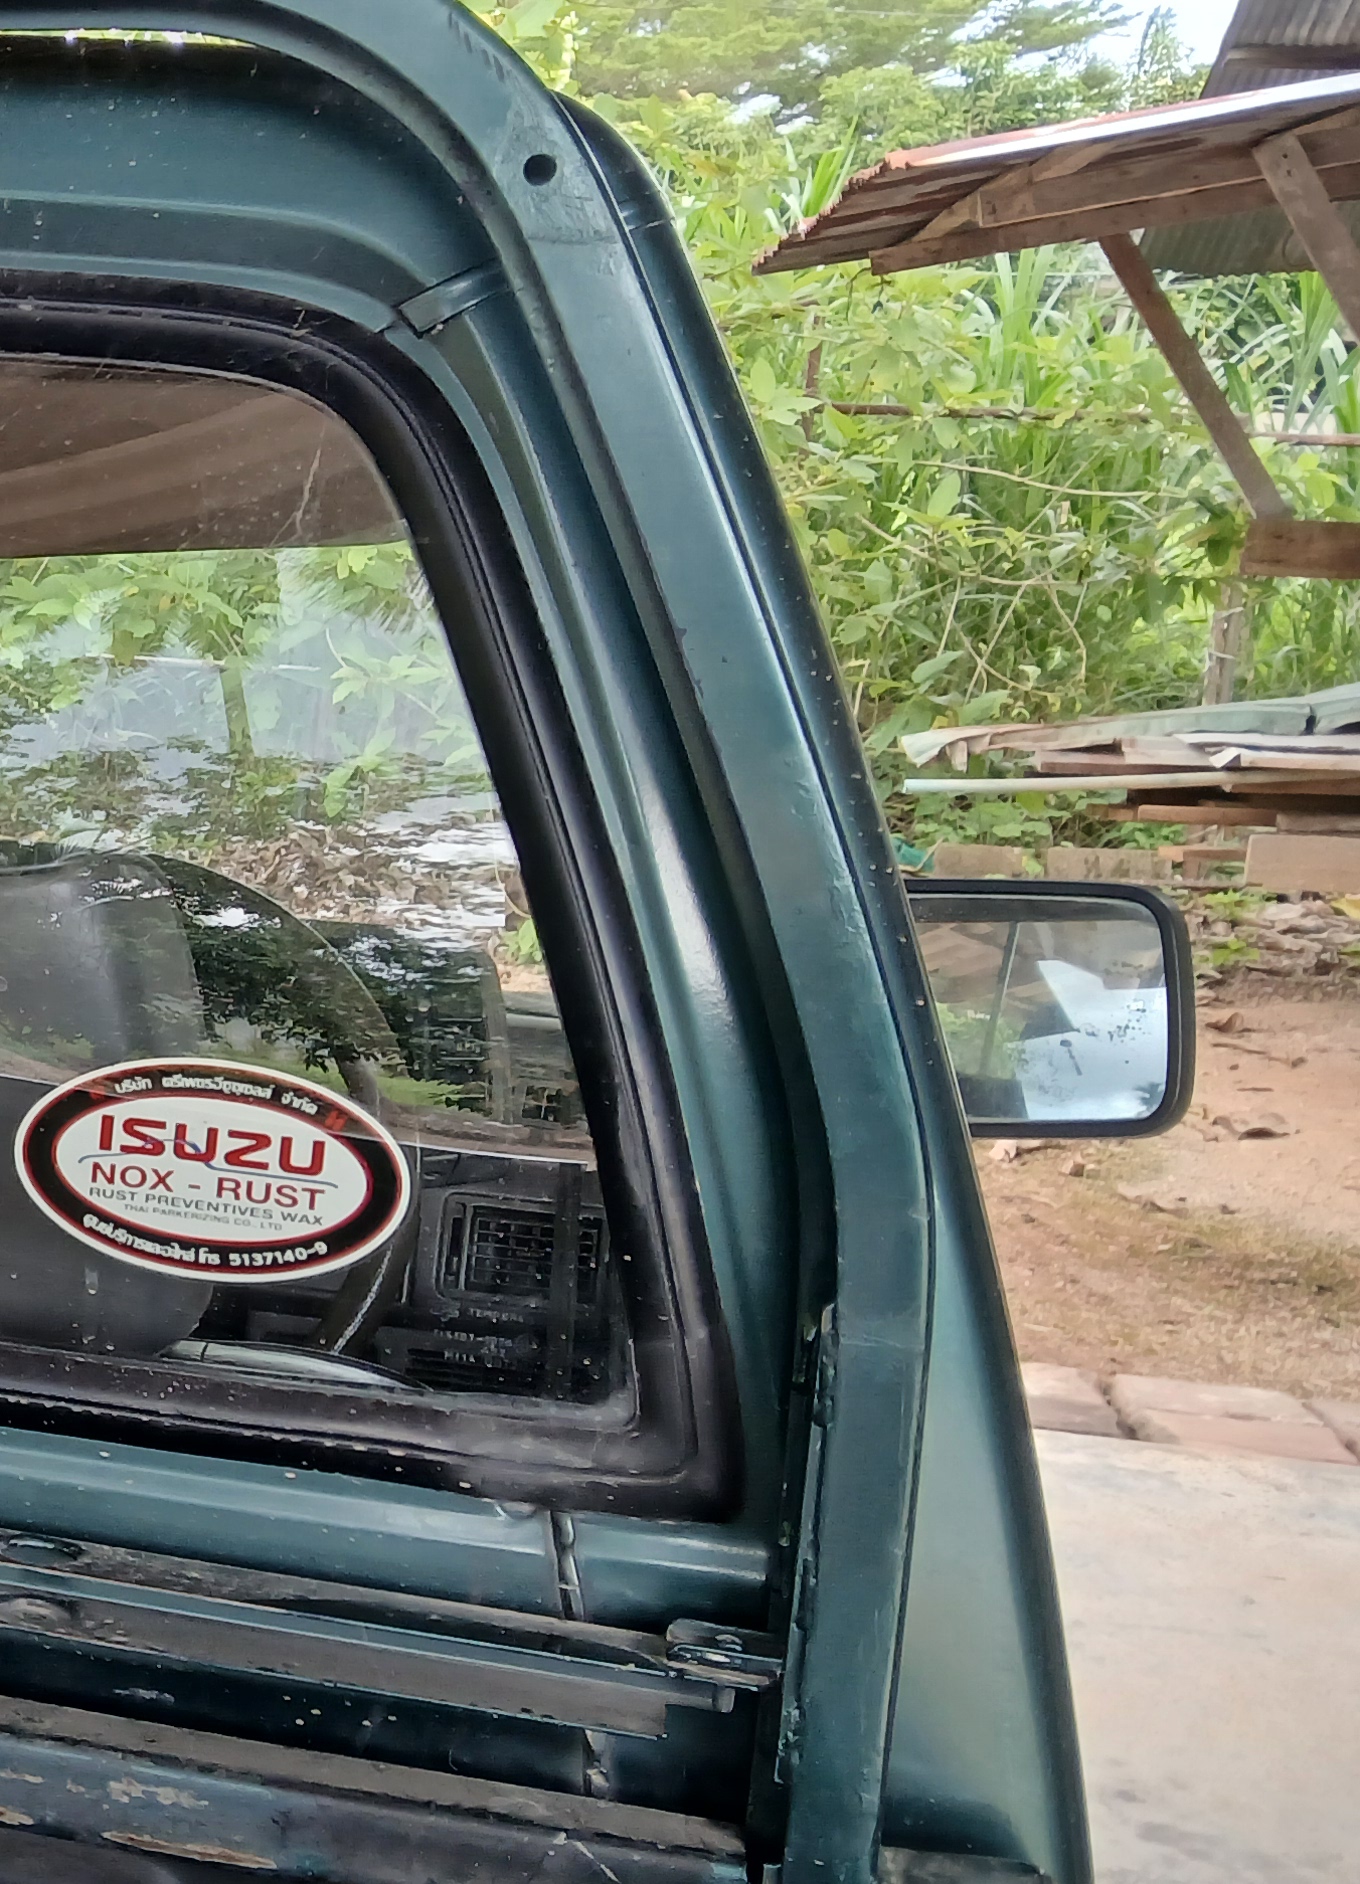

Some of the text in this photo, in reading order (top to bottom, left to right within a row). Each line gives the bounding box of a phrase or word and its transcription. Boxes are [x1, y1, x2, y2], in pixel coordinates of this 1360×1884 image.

[98, 1114, 327, 1176] ISUZU
[91, 1161, 175, 1193] NOX
[216, 1176, 326, 1211] RUST
[89, 1187, 324, 1226] RUST PREVENTIVES WAX
[124, 1203, 149, 1214] THAI
[229, 1241, 328, 1267] 5137140-9
